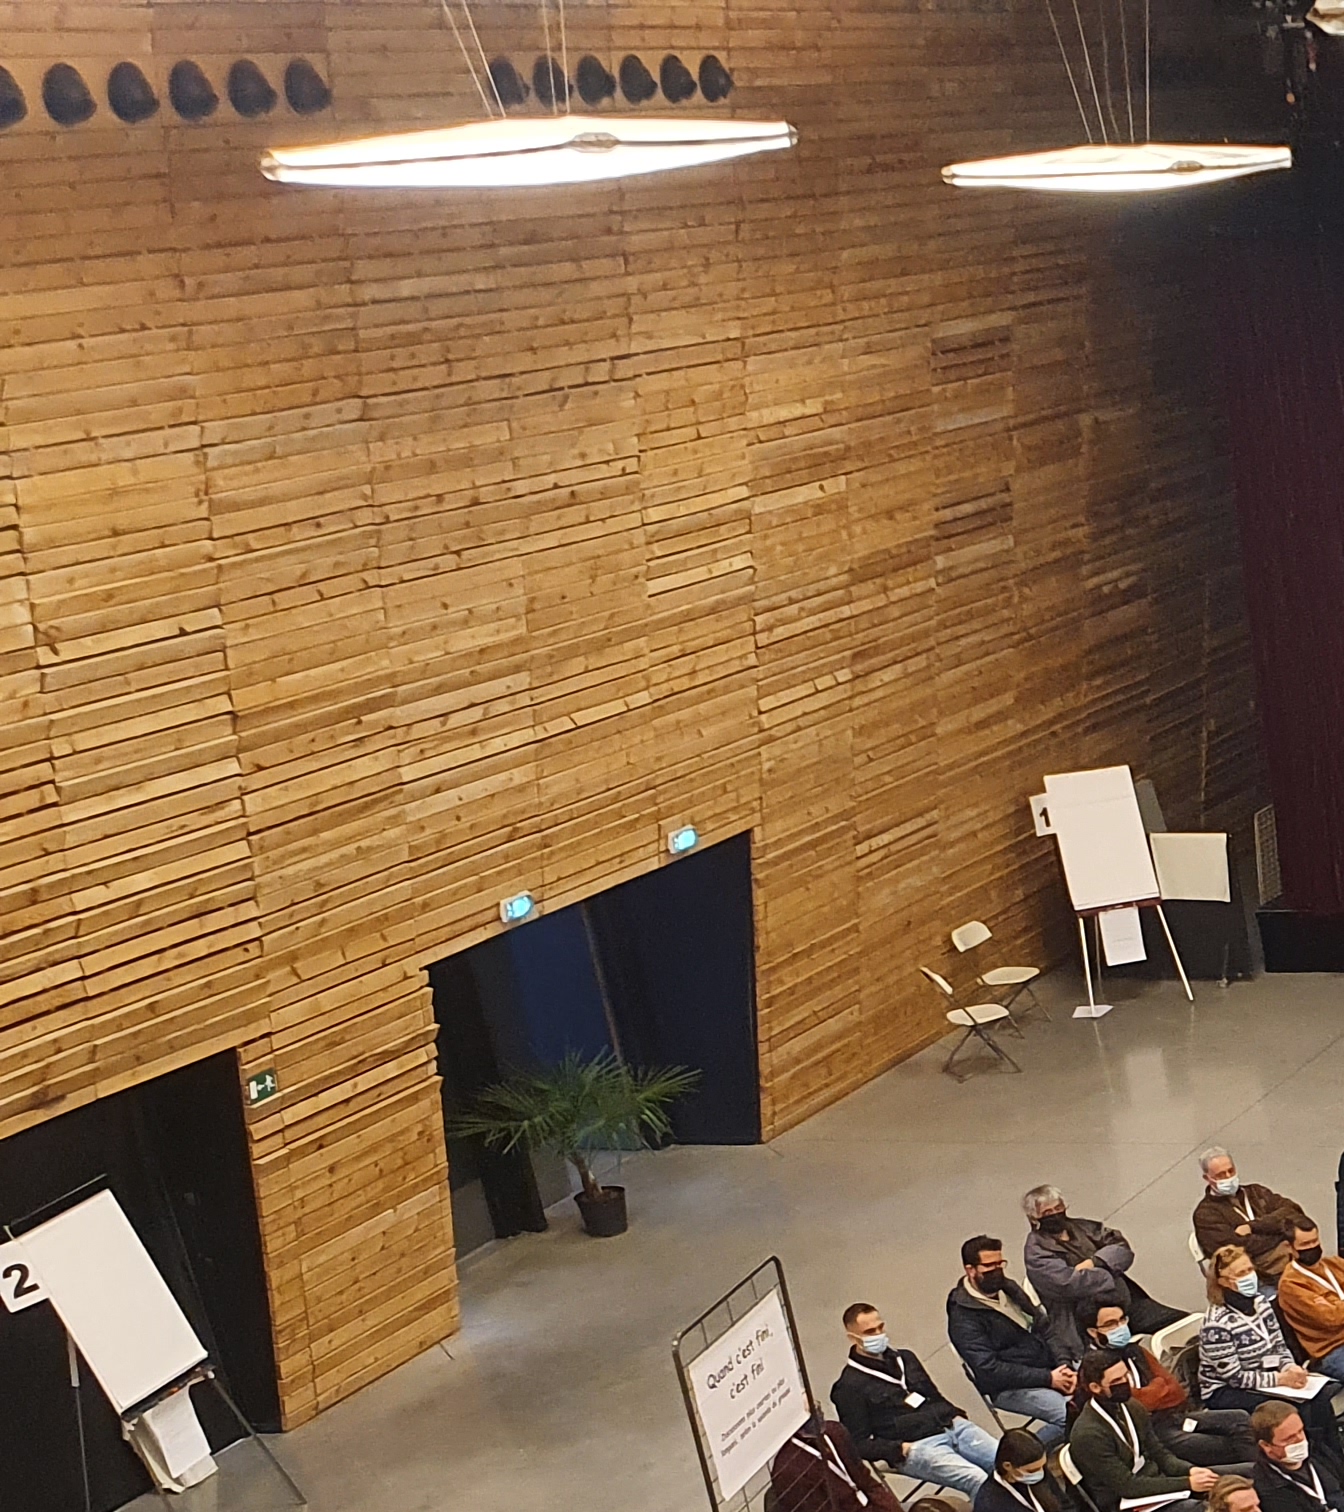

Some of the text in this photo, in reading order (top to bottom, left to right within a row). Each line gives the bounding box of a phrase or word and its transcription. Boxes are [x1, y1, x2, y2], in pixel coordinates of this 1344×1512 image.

[1039, 807, 1051, 827] 1
[2, 1263, 40, 1300] 2
[706, 1324, 774, 1390] Quand c'est fini,
[729, 1358, 765, 1400] c'est fini
